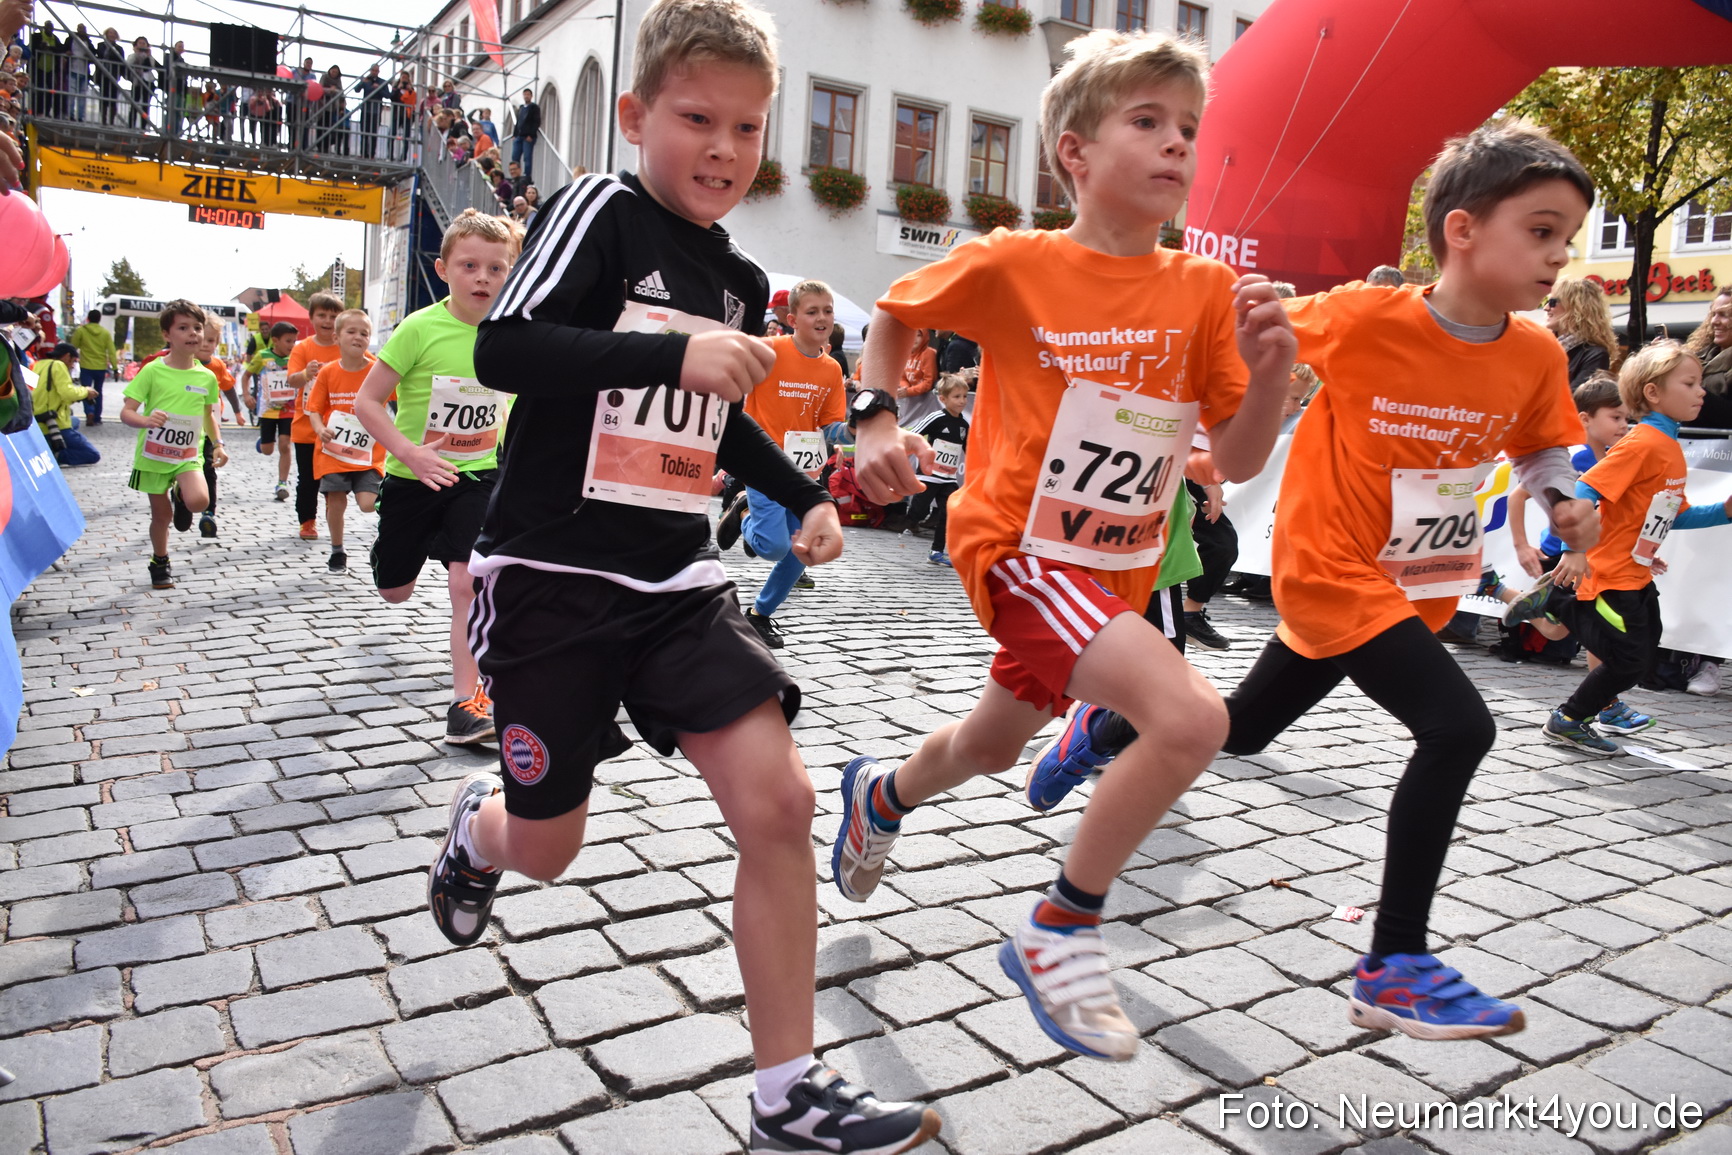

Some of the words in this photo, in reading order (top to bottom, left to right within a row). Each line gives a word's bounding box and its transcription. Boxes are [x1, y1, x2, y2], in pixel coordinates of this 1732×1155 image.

[181, 174, 257, 203] ZIEL
[899, 226, 941, 245] swn
[1183, 225, 1259, 269] STORE
[634, 285, 671, 300] adidas
[1645, 262, 1716, 303] Beck
[130, 300, 157, 311] MINI
[1030, 326, 1158, 347] Neumarkter
[779, 390, 811, 400] Stadtlauf
[443, 402, 497, 430] 7083
[603, 413, 619, 426] B4
[1372, 396, 1486, 424] Neumarkter
[1134, 413, 1181, 432] BOCK
[1368, 418, 1460, 446] Stadtlauf
[156, 426, 194, 446] 7080
[335, 426, 370, 448] 7136
[450, 437, 483, 447] Leander
[660, 453, 702, 479] Tobias
[1072, 440, 1175, 505] 7240
[1400, 560, 1474, 577] Maximilian
